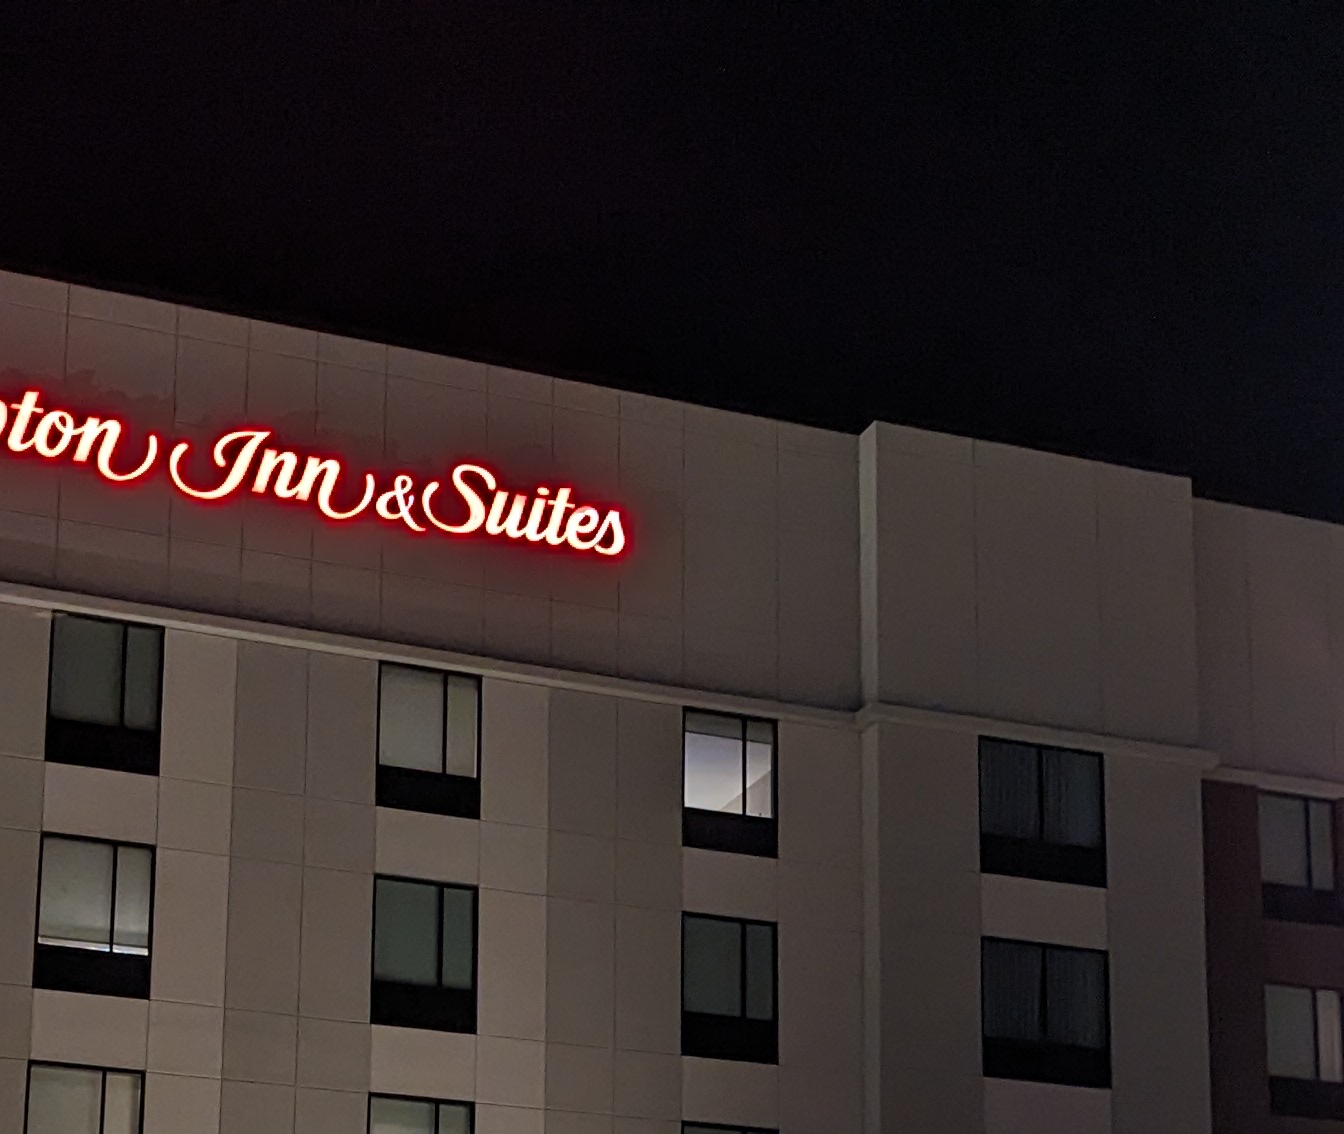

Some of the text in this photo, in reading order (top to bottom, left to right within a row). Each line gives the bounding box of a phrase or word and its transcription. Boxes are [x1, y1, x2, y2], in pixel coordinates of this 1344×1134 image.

[169, 431, 375, 519] Inn
[375, 475, 427, 532] &
[422, 464, 626, 556] Suites
